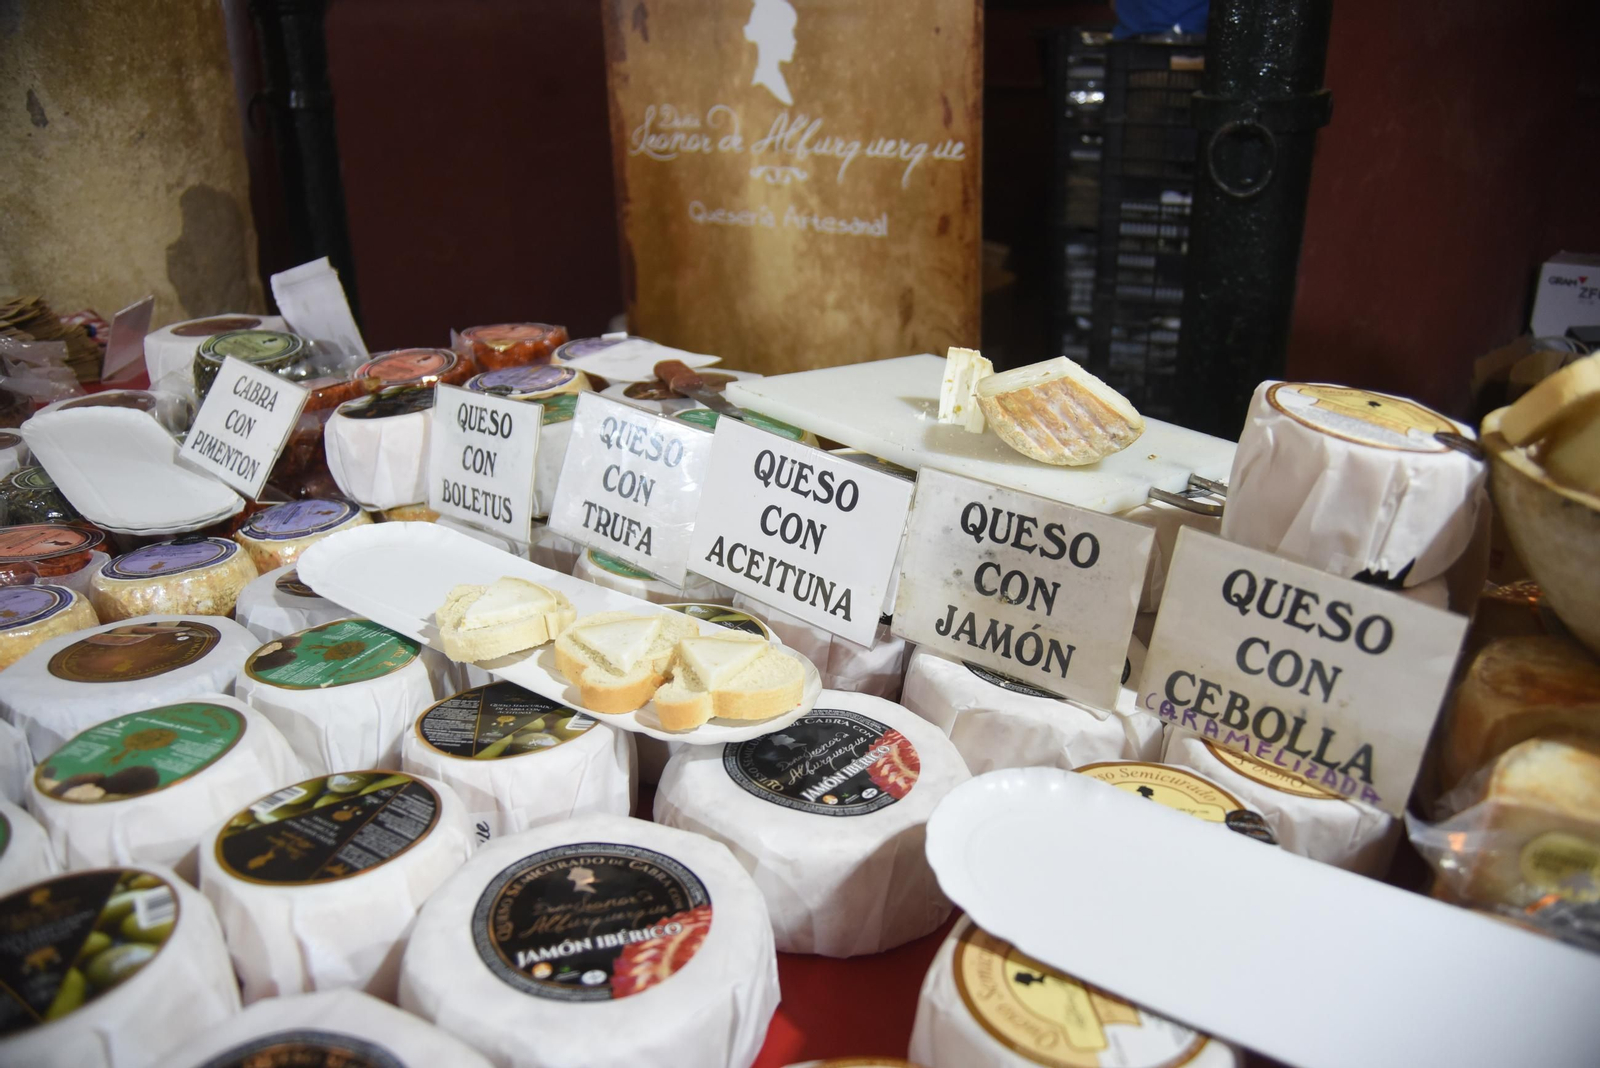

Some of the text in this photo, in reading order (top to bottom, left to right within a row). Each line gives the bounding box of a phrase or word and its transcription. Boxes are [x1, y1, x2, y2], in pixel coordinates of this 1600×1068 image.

[629, 104, 712, 161] Leonor
[782, 204, 889, 238] Artesanal
[233, 375, 279, 412] CABRA
[225, 409, 257, 439] CON
[457, 402, 513, 439] QUESO
[600, 416, 684, 468] QUESO
[191, 430, 261, 482] PIMENTON
[462, 445, 497, 478] CON
[754, 449, 859, 512] QUESO
[442, 478, 513, 524] BOLETUS
[602, 464, 656, 507] CON
[582, 499, 652, 556] TRUFA
[760, 504, 827, 555] CON
[960, 501, 1100, 568] QUESO
[705, 535, 852, 622] ACEITUNA
[974, 561, 1061, 616] CON
[1222, 568, 1394, 655] QUESO
[935, 604, 1076, 679] JAMÓN
[1236, 637, 1342, 703] CON
[1164, 670, 1375, 785] CEBOLLA
[748, 767, 784, 791] QUESO
[804, 718, 850, 727] CABRA
[852, 725, 874, 738] CON
[800, 745, 891, 802] JAMÓN IBÉRICO
[1119, 767, 1217, 802] Semicurado
[504, 857, 605, 898] SEMICURADO
[628, 860, 672, 888] CABRA
[515, 921, 684, 969] JAMÓN IBÉRICO
